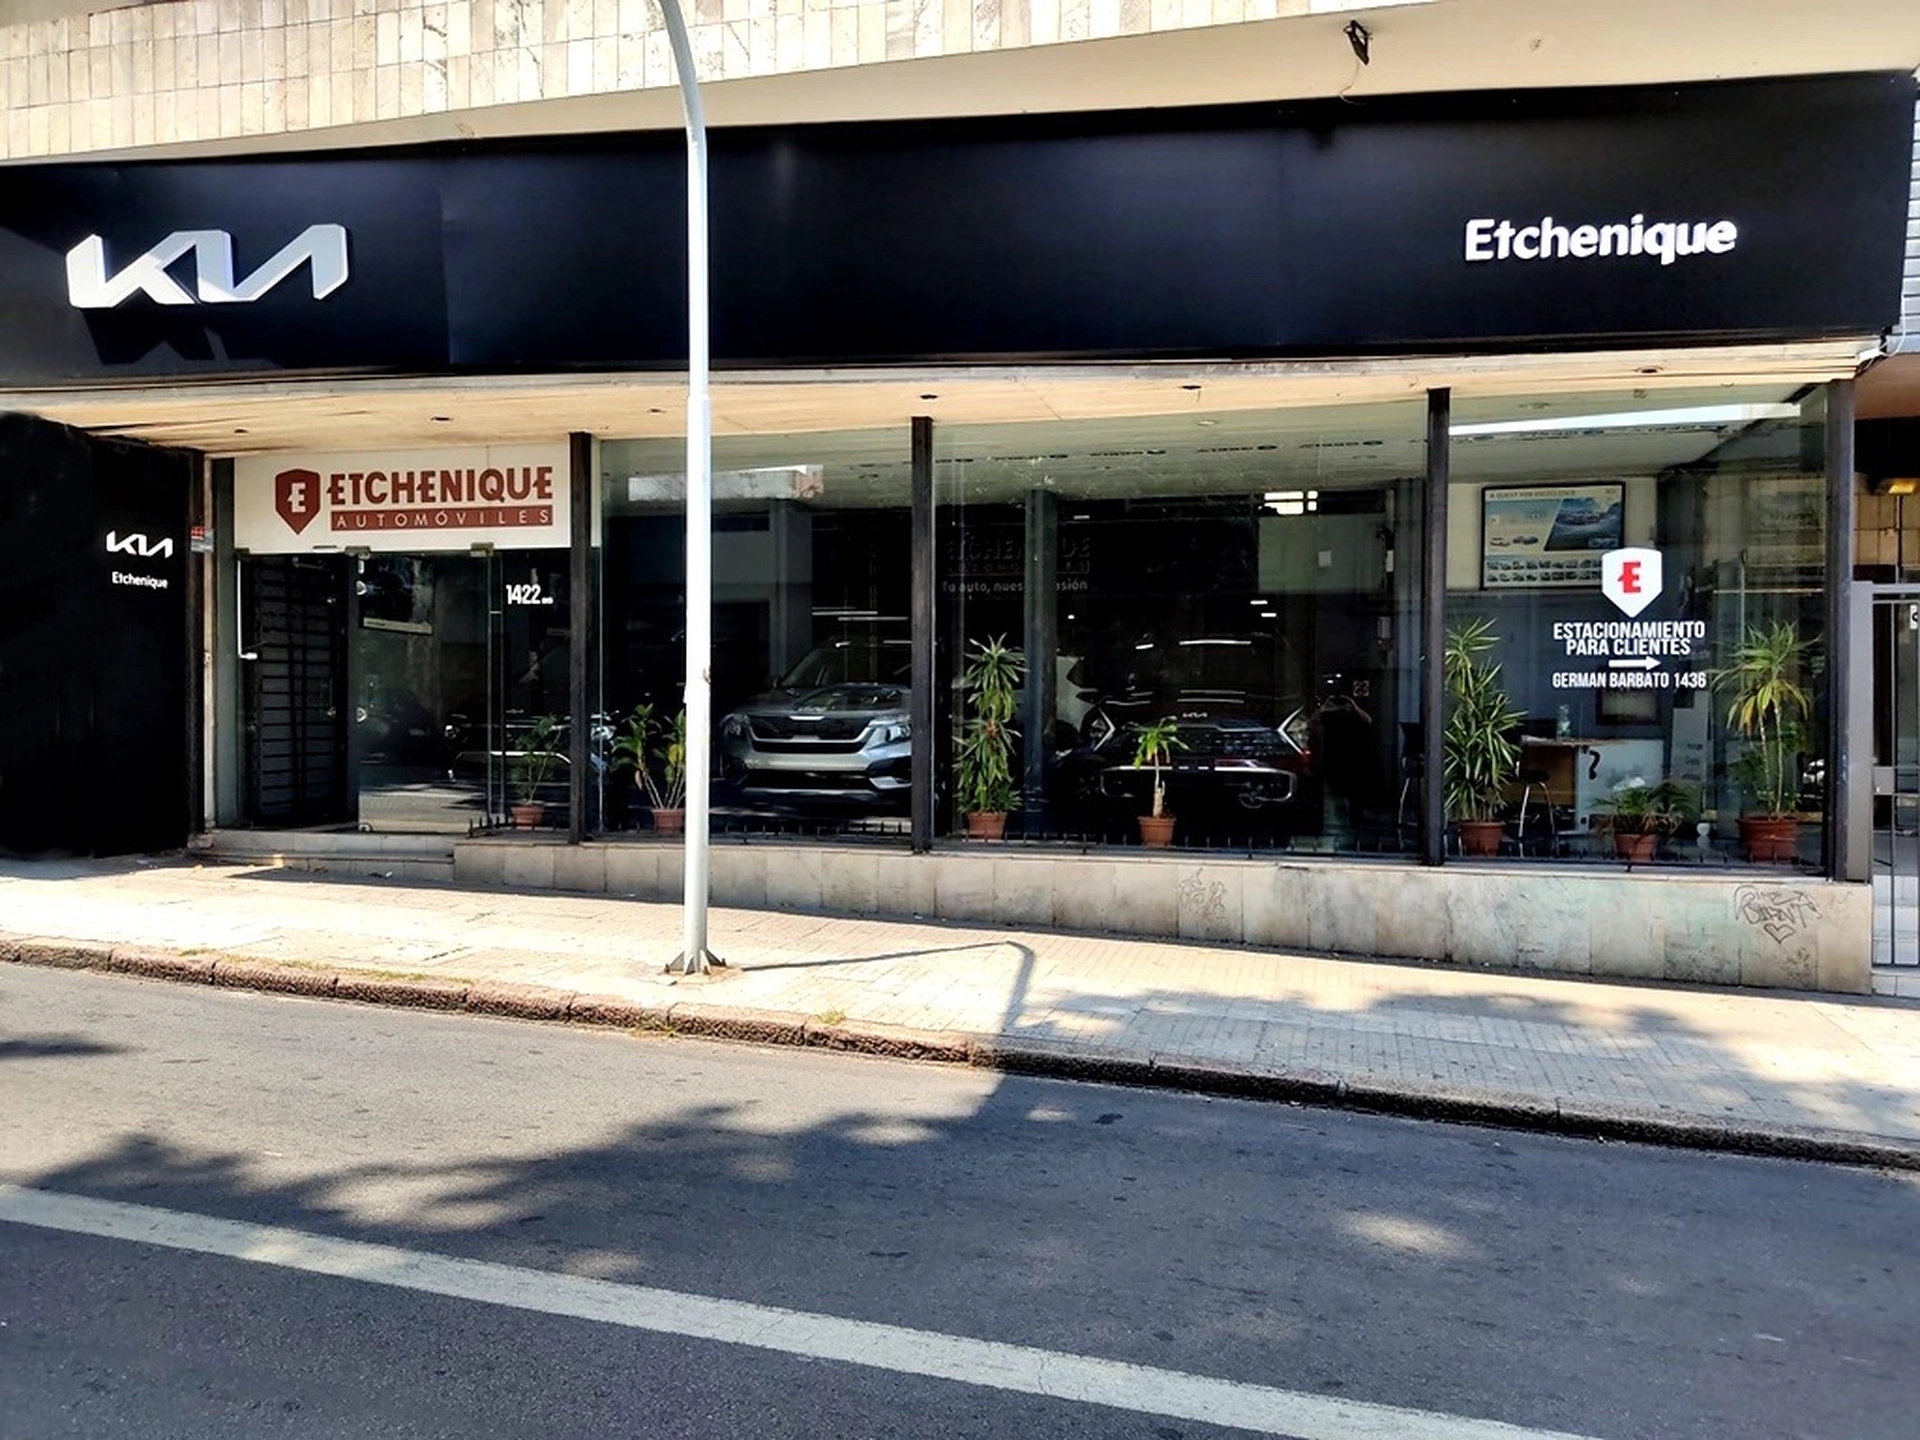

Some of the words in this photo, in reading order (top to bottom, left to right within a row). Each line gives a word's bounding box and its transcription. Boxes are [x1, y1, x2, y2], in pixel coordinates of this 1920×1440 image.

[1465, 213, 1738, 265] Etchenique
[65, 223, 349, 309] KIA
[326, 466, 554, 506] ETCHENIQUE
[336, 509, 551, 528] AUTOMÓVILES
[106, 530, 174, 559] KIA
[111, 571, 169, 590] Etchenique
[505, 583, 542, 605] 1422
[1553, 621, 1705, 640] ESTACIONAMIENTO
[1566, 639, 1611, 656] PARA
[1613, 639, 1691, 656] CLIENTES
[1552, 672, 1607, 689] GERMAN
[1609, 672, 1671, 689] BARBATO
[1674, 671, 1707, 689] 1436
